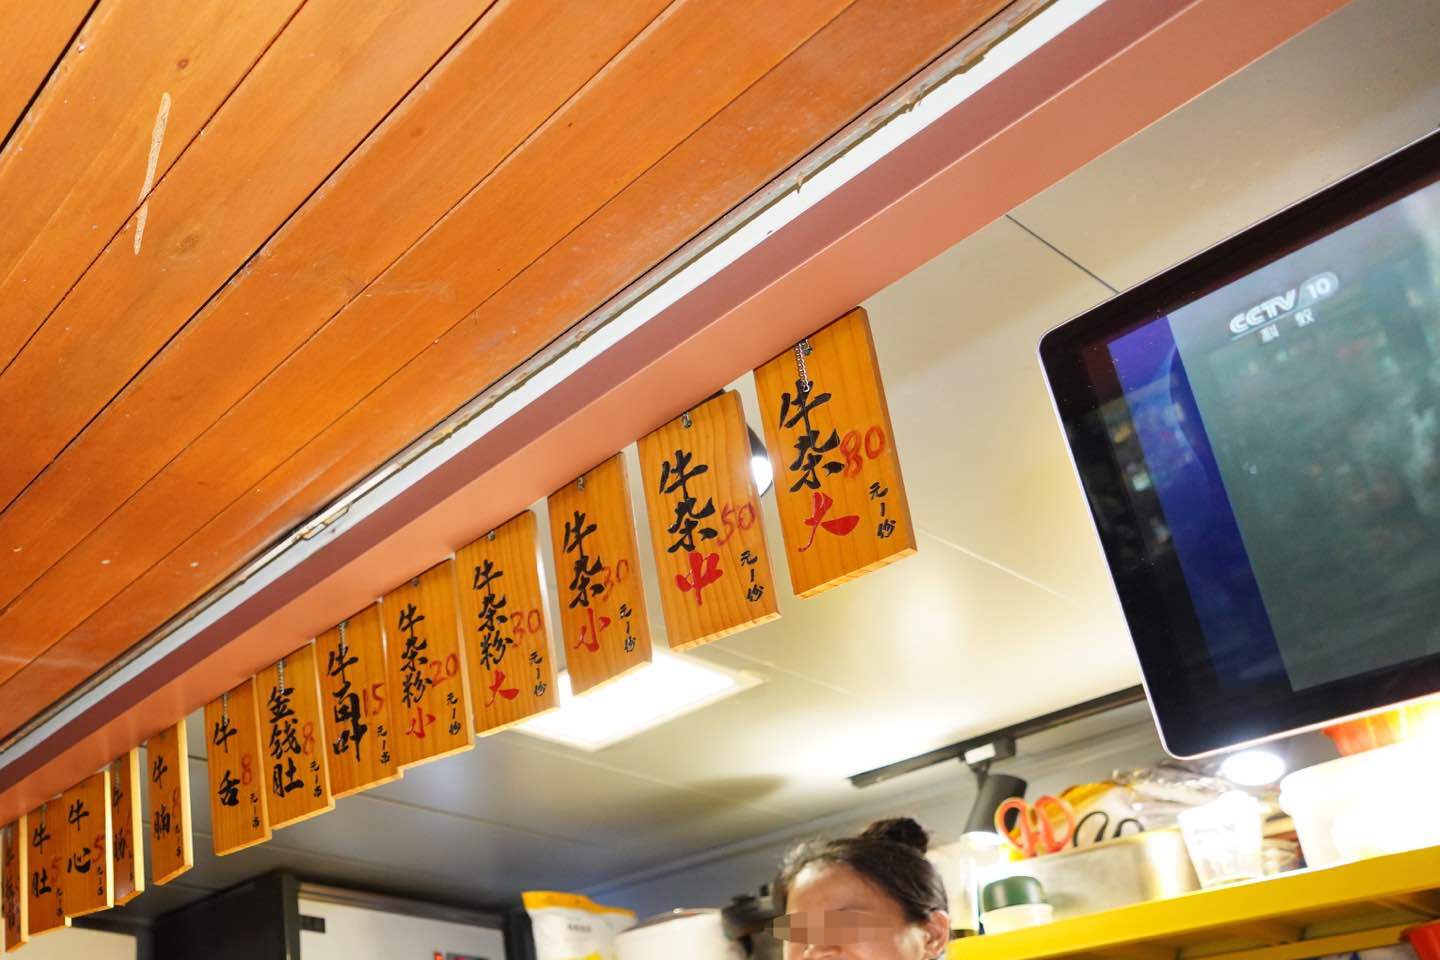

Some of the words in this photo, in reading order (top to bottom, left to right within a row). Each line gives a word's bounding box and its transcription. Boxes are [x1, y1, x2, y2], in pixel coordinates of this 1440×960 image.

[362, 682, 386, 719] 15
[240, 752, 253, 786] 8
[66, 799, 92, 874] 牛心
